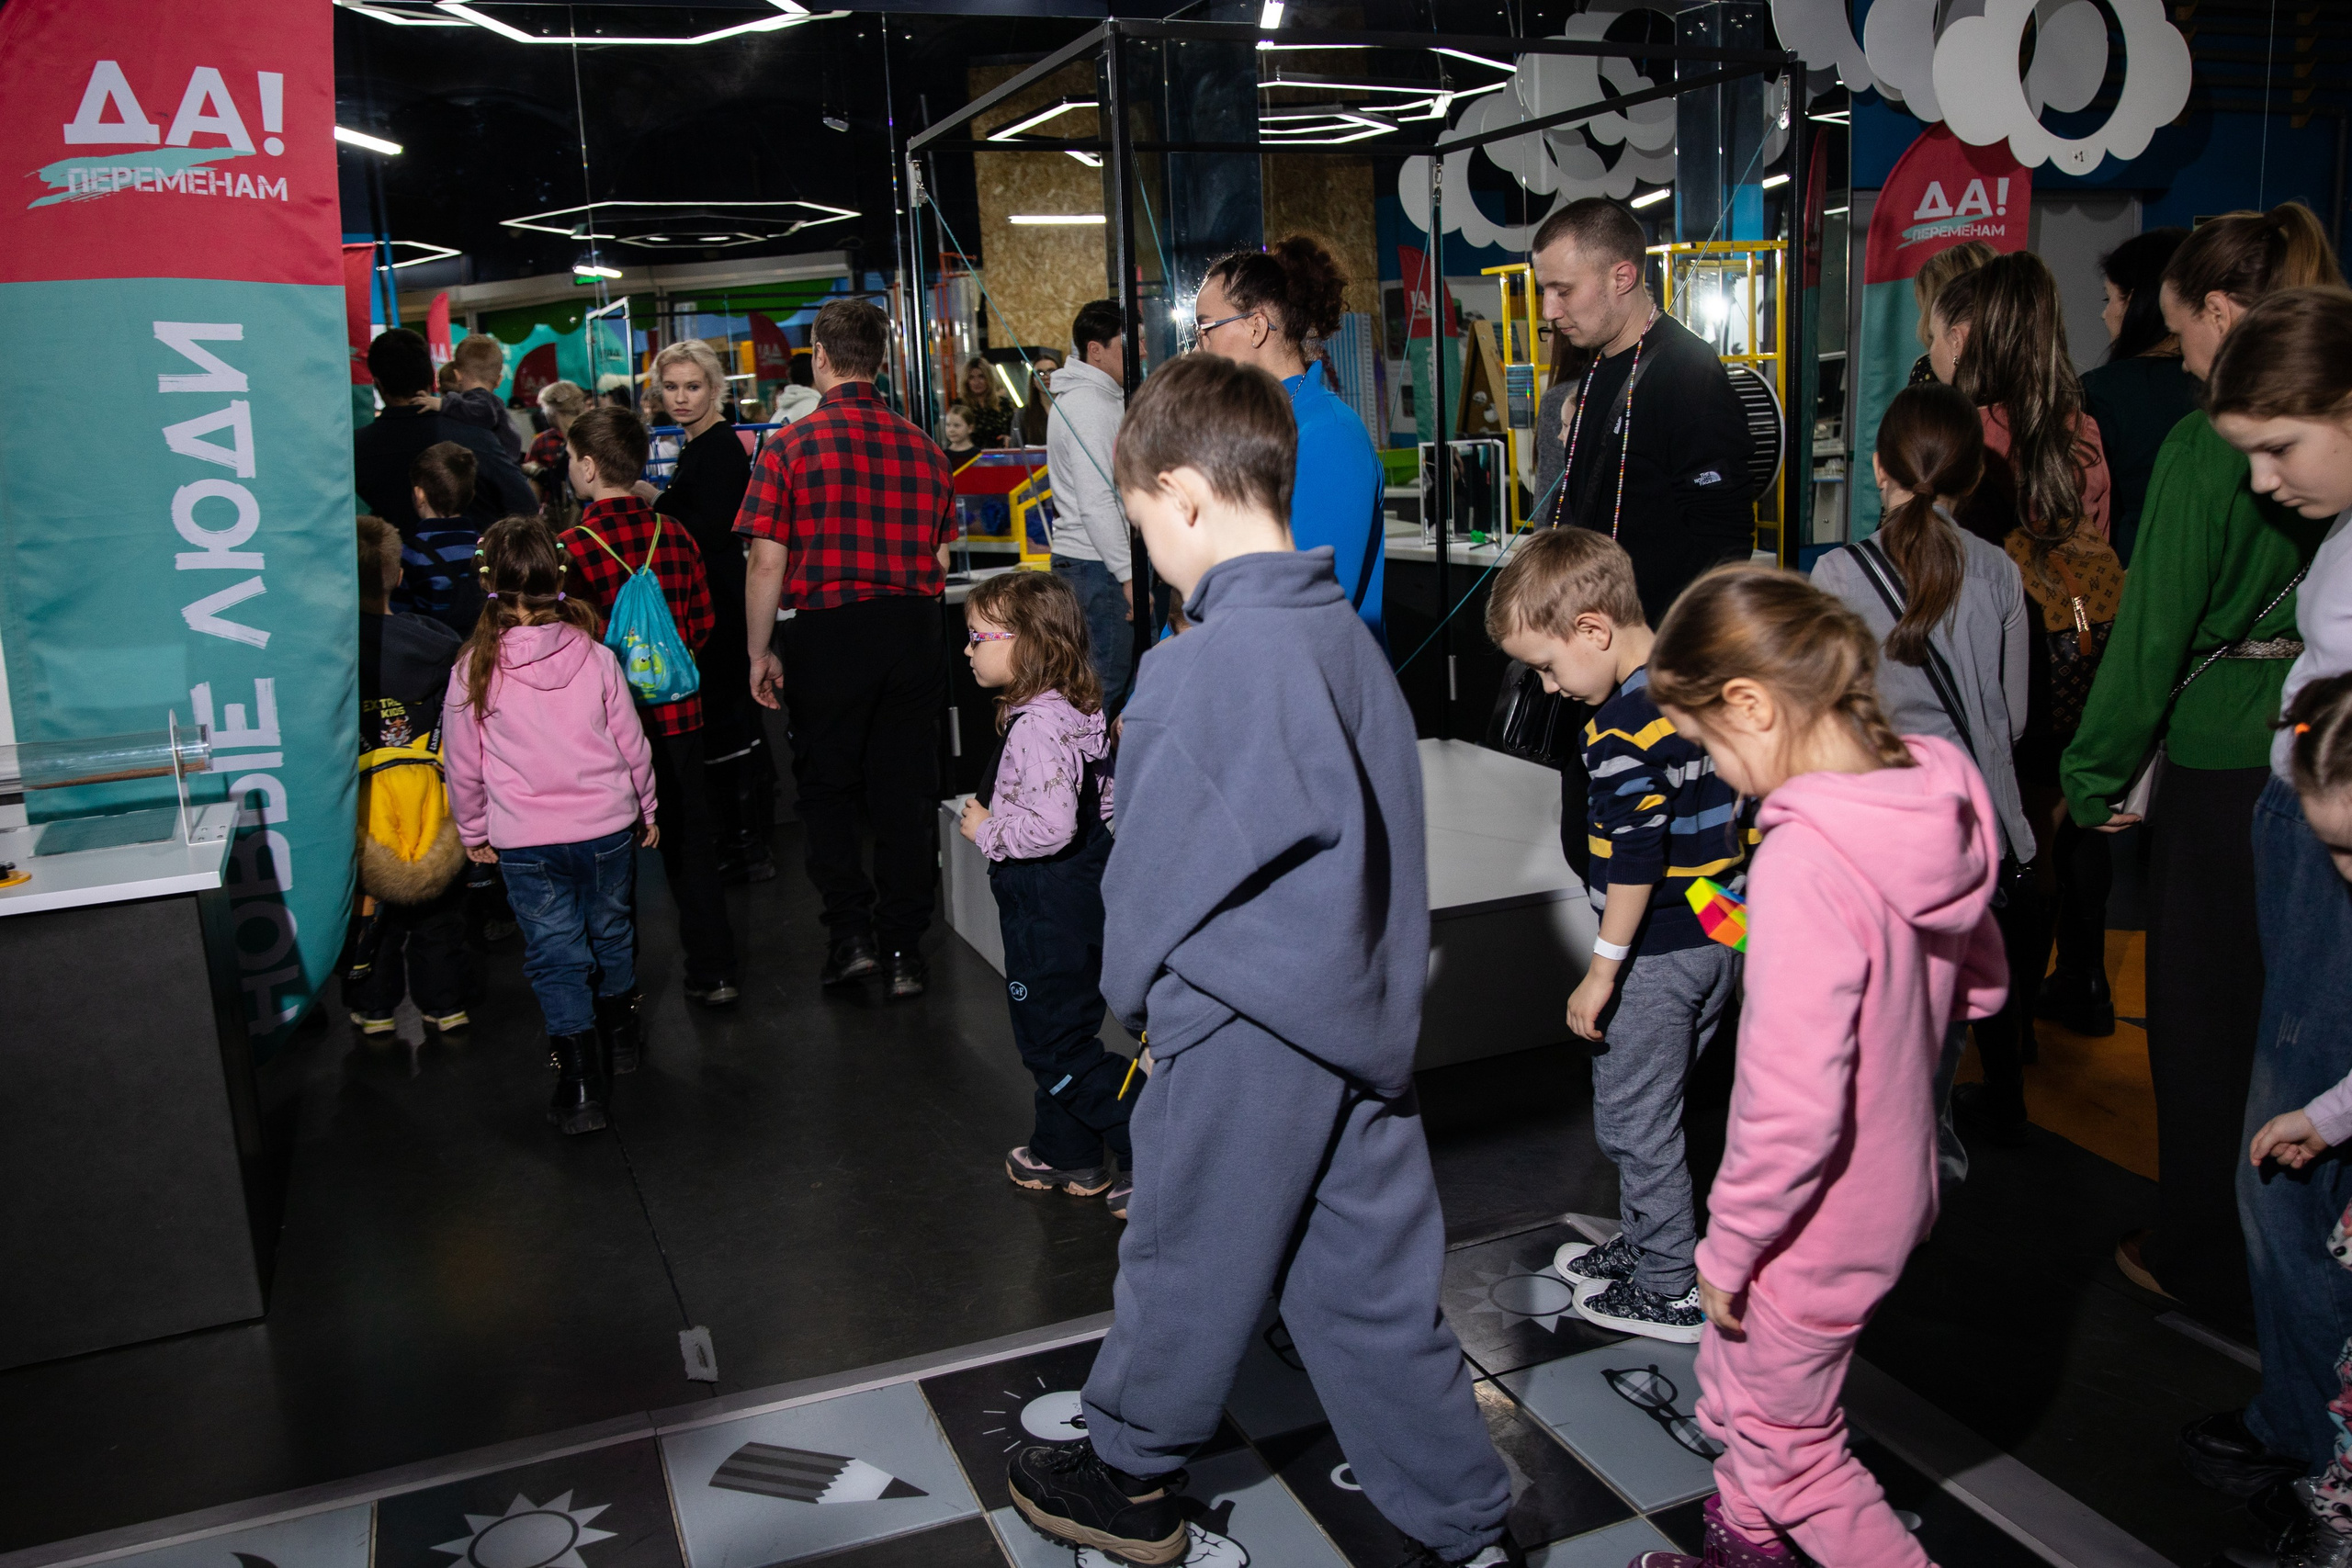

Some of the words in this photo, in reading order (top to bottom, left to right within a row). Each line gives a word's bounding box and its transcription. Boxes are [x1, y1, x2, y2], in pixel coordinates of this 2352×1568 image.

[62, 60, 285, 156] ДА!
[67, 166, 288, 202] ПЕРЕМЕНАМ
[1913, 177, 2010, 220] ДА!
[1911, 223, 2006, 243] ПЕРЕМЕНАМ
[153, 321, 272, 649] ЛЮДИ
[363, 698, 423, 713] EXTR
[380, 705, 406, 718] KIDS
[190, 678, 300, 1036] НОВЫЕ
